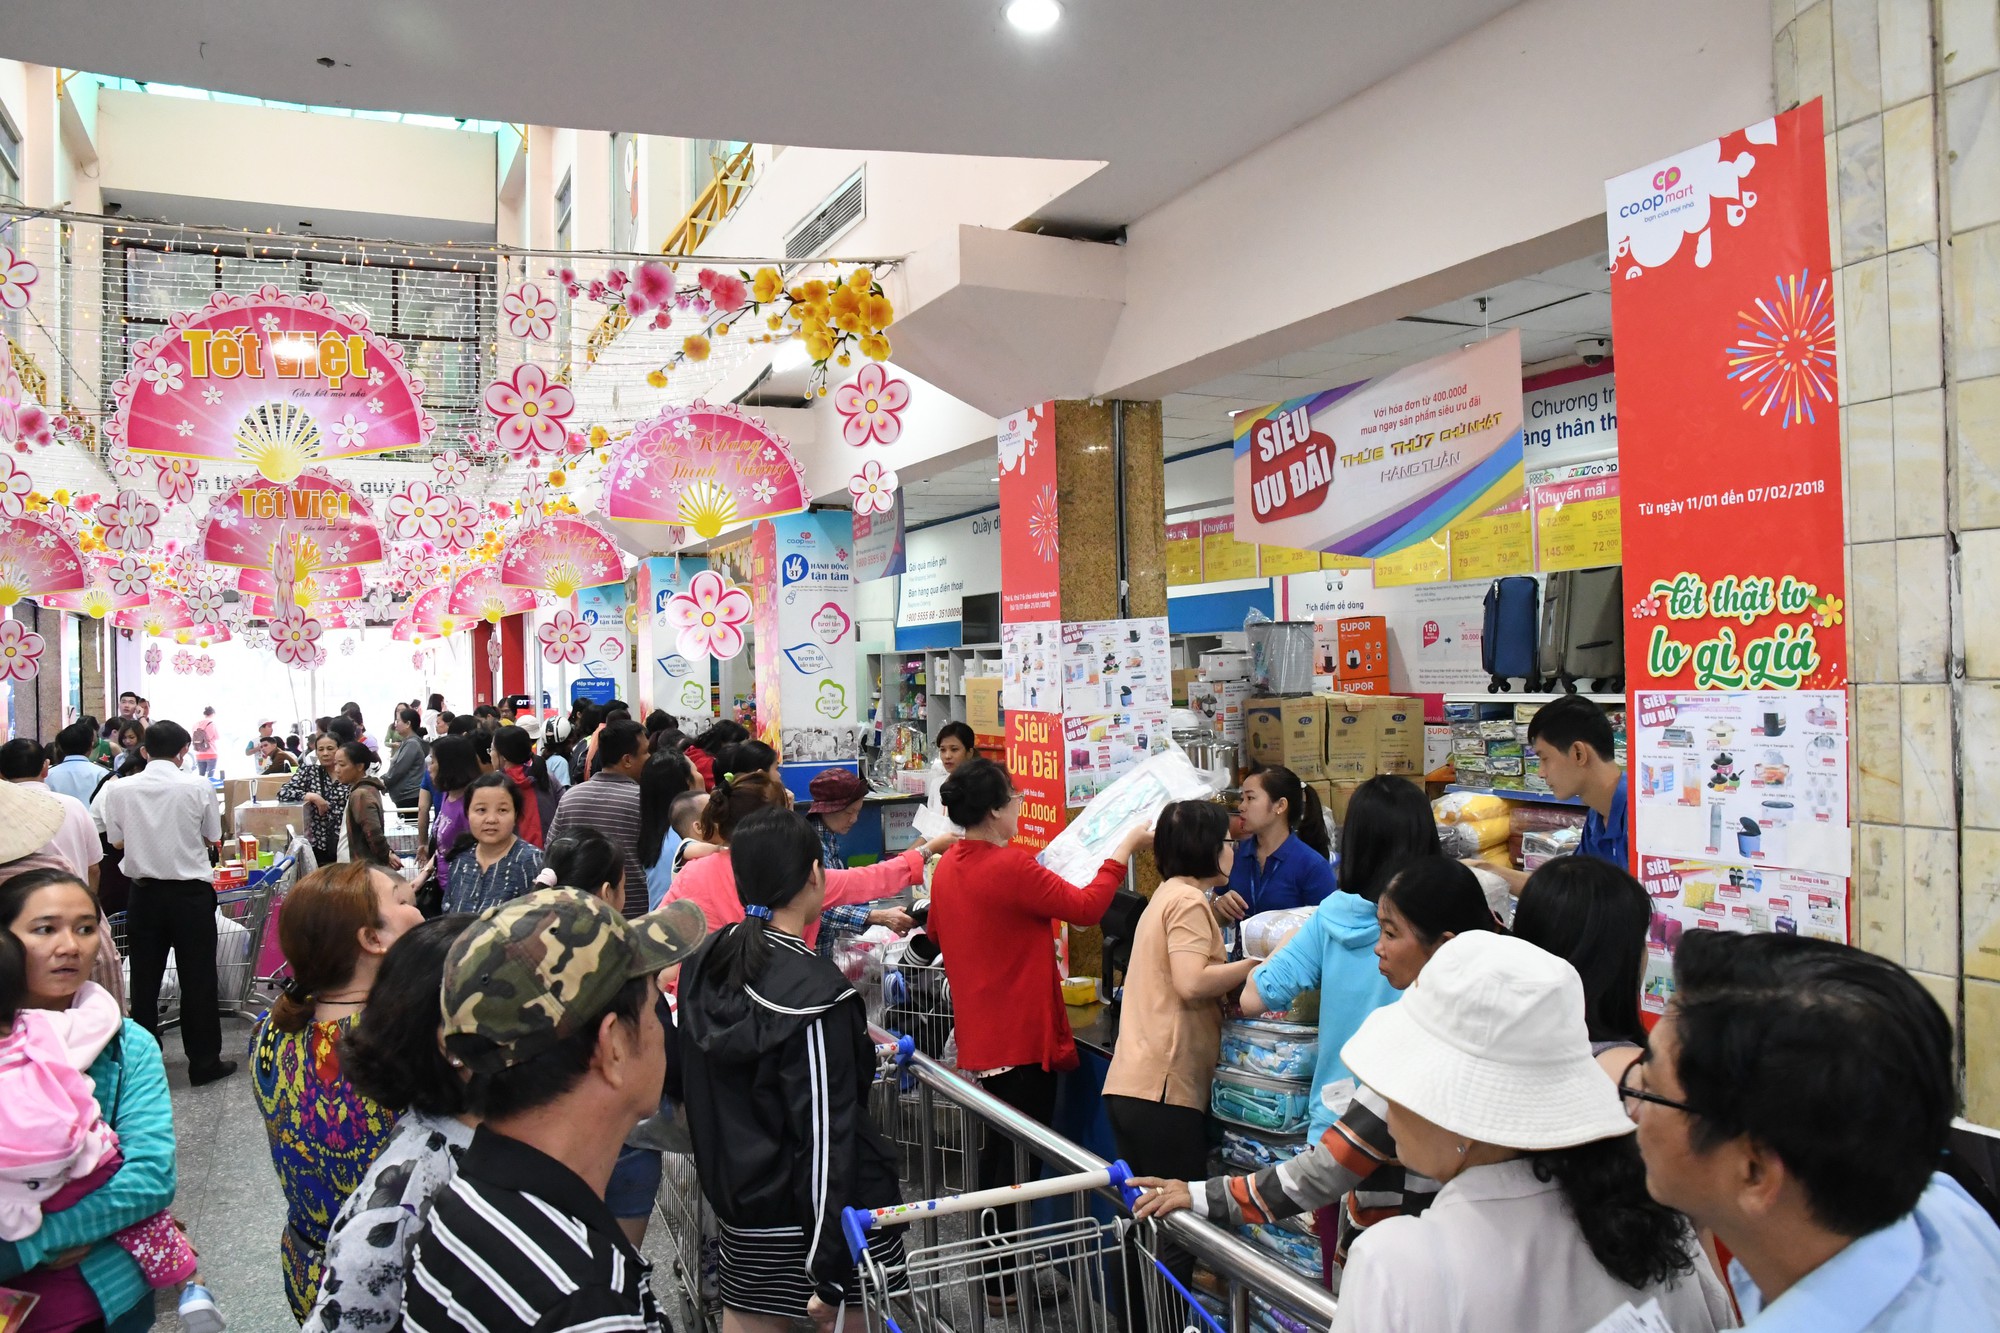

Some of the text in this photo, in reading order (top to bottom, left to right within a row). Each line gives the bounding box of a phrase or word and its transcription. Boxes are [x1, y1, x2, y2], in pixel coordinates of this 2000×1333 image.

[182, 326, 370, 390] Tết Việt
[1374, 384, 1468, 418] Với hóa đơn từ 400.000đ
[1532, 392, 1598, 418] Chương
[1360, 395, 1481, 436] mua ngay sản phẩm siêu ưu đãi
[1258, 406, 1310, 462] SIÊU
[1556, 418, 1594, 440] thân
[1253, 444, 1332, 515] ƯU ĐÃI
[1538, 483, 1606, 506] Khuyến mãi
[1639, 480, 1825, 516] Từ ngày 11/01 đến 07/02/2018
[237, 486, 351, 527] Tết Việt
[973, 516, 992, 535] Quầy
[1203, 520, 1228, 534] Khuyến
[811, 562, 848, 571] HÀNH ĐỘNG
[811, 571, 848, 582] tận tâm
[1655, 576, 1813, 621] Tết thật to
[1340, 622, 1370, 632] SUPOR
[1424, 624, 1438, 632] 150
[1651, 628, 1816, 688] lo gì giá
[1344, 682, 1374, 692] SUPOR
[1643, 694, 1667, 710] SIÊU
[1642, 711, 1657, 726] ƯU
[1658, 706, 1676, 722] ĐÃI
[1015, 714, 1048, 744] Siêu
[1007, 744, 1058, 780] Ưu Đãi
[1024, 823, 1044, 835] mua ngay
[1646, 858, 1671, 876] SIÊU
[1645, 875, 1681, 894] ƯU ĐÃI
